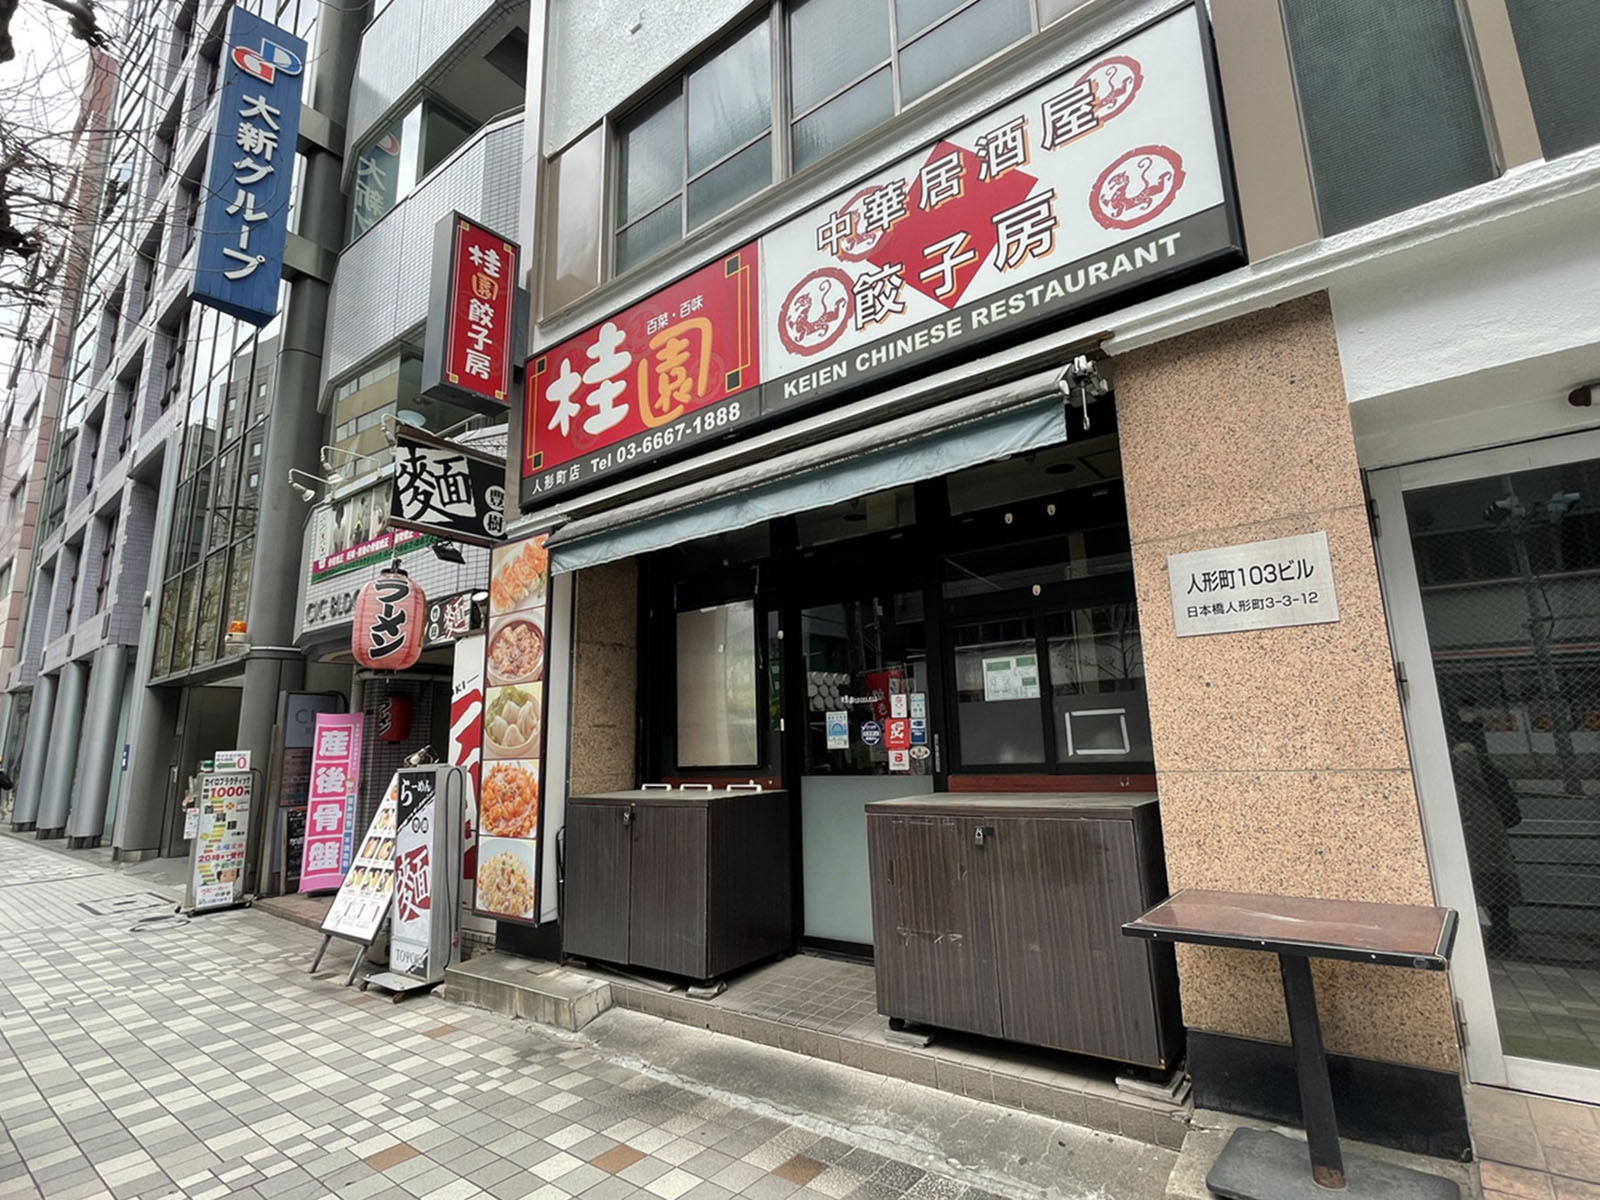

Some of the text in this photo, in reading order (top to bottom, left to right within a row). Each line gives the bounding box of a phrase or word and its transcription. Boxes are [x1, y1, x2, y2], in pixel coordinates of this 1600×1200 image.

[222, 94, 281, 281] 大新グループ
[816, 79, 1103, 257] 中華居酒屋
[783, 232, 1182, 399] KEIEN CHINESE RESTAURANT
[853, 190, 1058, 332] 餃子房
[545, 316, 713, 437] 桂園
[532, 403, 741, 496] 人形町店 Tel 03-6667-1888
[369, 579, 410, 660] ラーメン
[1187, 558, 1315, 595] 人形町103ビル
[1187, 591, 1319, 619] 日本橋人形町3-3-12
[307, 730, 349, 872] 産後骨盤
[400, 778, 432, 806] らーめん
